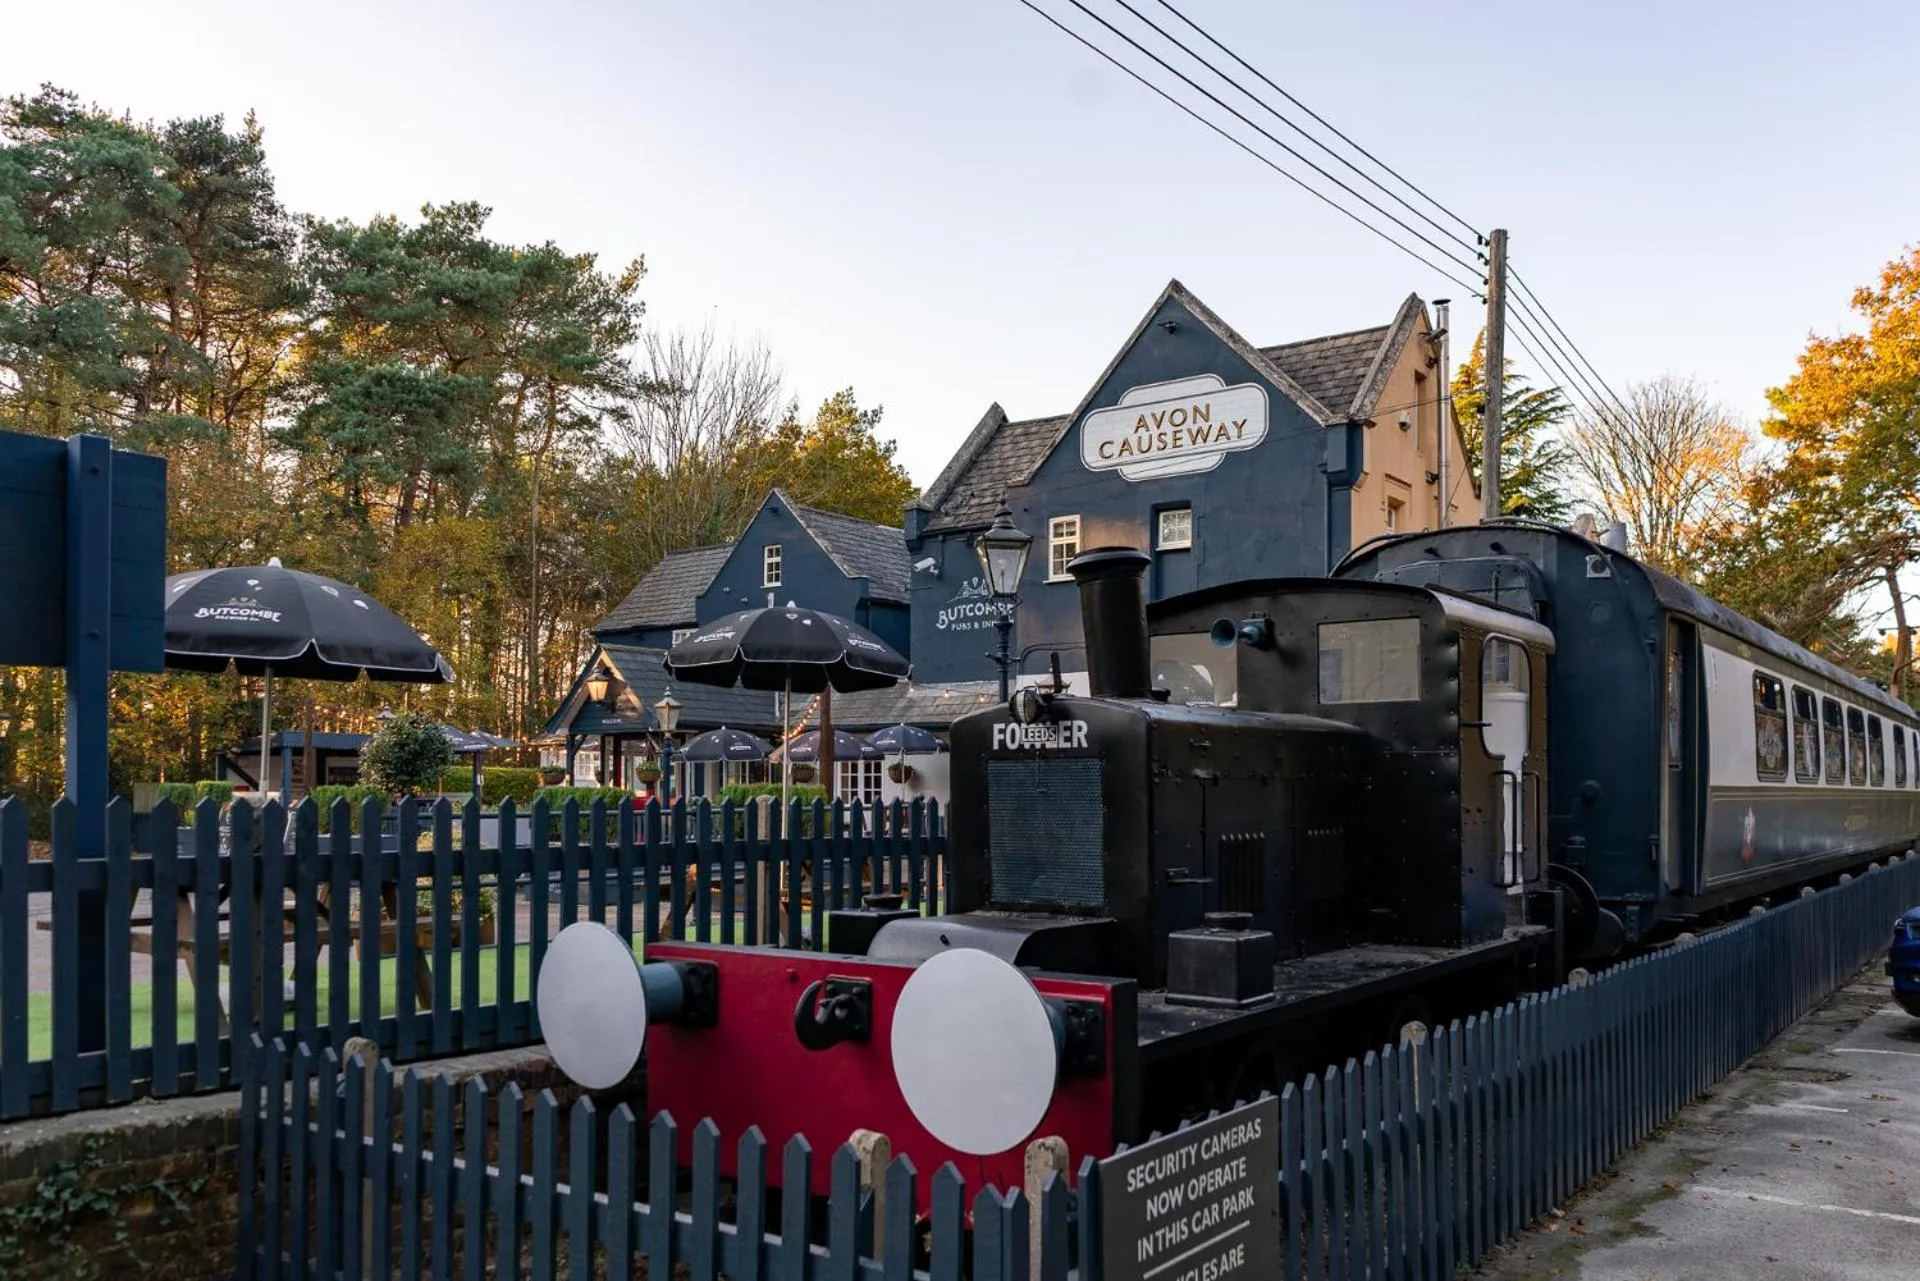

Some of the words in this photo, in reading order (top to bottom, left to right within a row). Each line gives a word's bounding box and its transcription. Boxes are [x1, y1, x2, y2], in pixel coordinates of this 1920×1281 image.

[1133, 403, 1211, 434] AVON
[1098, 418, 1248, 459] CAUSEWAY
[194, 607, 282, 622] BUTCOMBE
[1022, 726, 1056, 742] LEEDS
[1126, 1142, 1198, 1193] SECURITY
[1201, 1117, 1262, 1160] CAMERAS
[1146, 1183, 1184, 1222] NOW
[1187, 1156, 1247, 1201] OPERATE
[1137, 1232, 1154, 1263] IN
[1155, 1217, 1188, 1252] THIS
[1191, 1203, 1220, 1235] CAR
[1222, 1185, 1255, 1220] PARK
[1219, 1243, 1245, 1277] ARE
